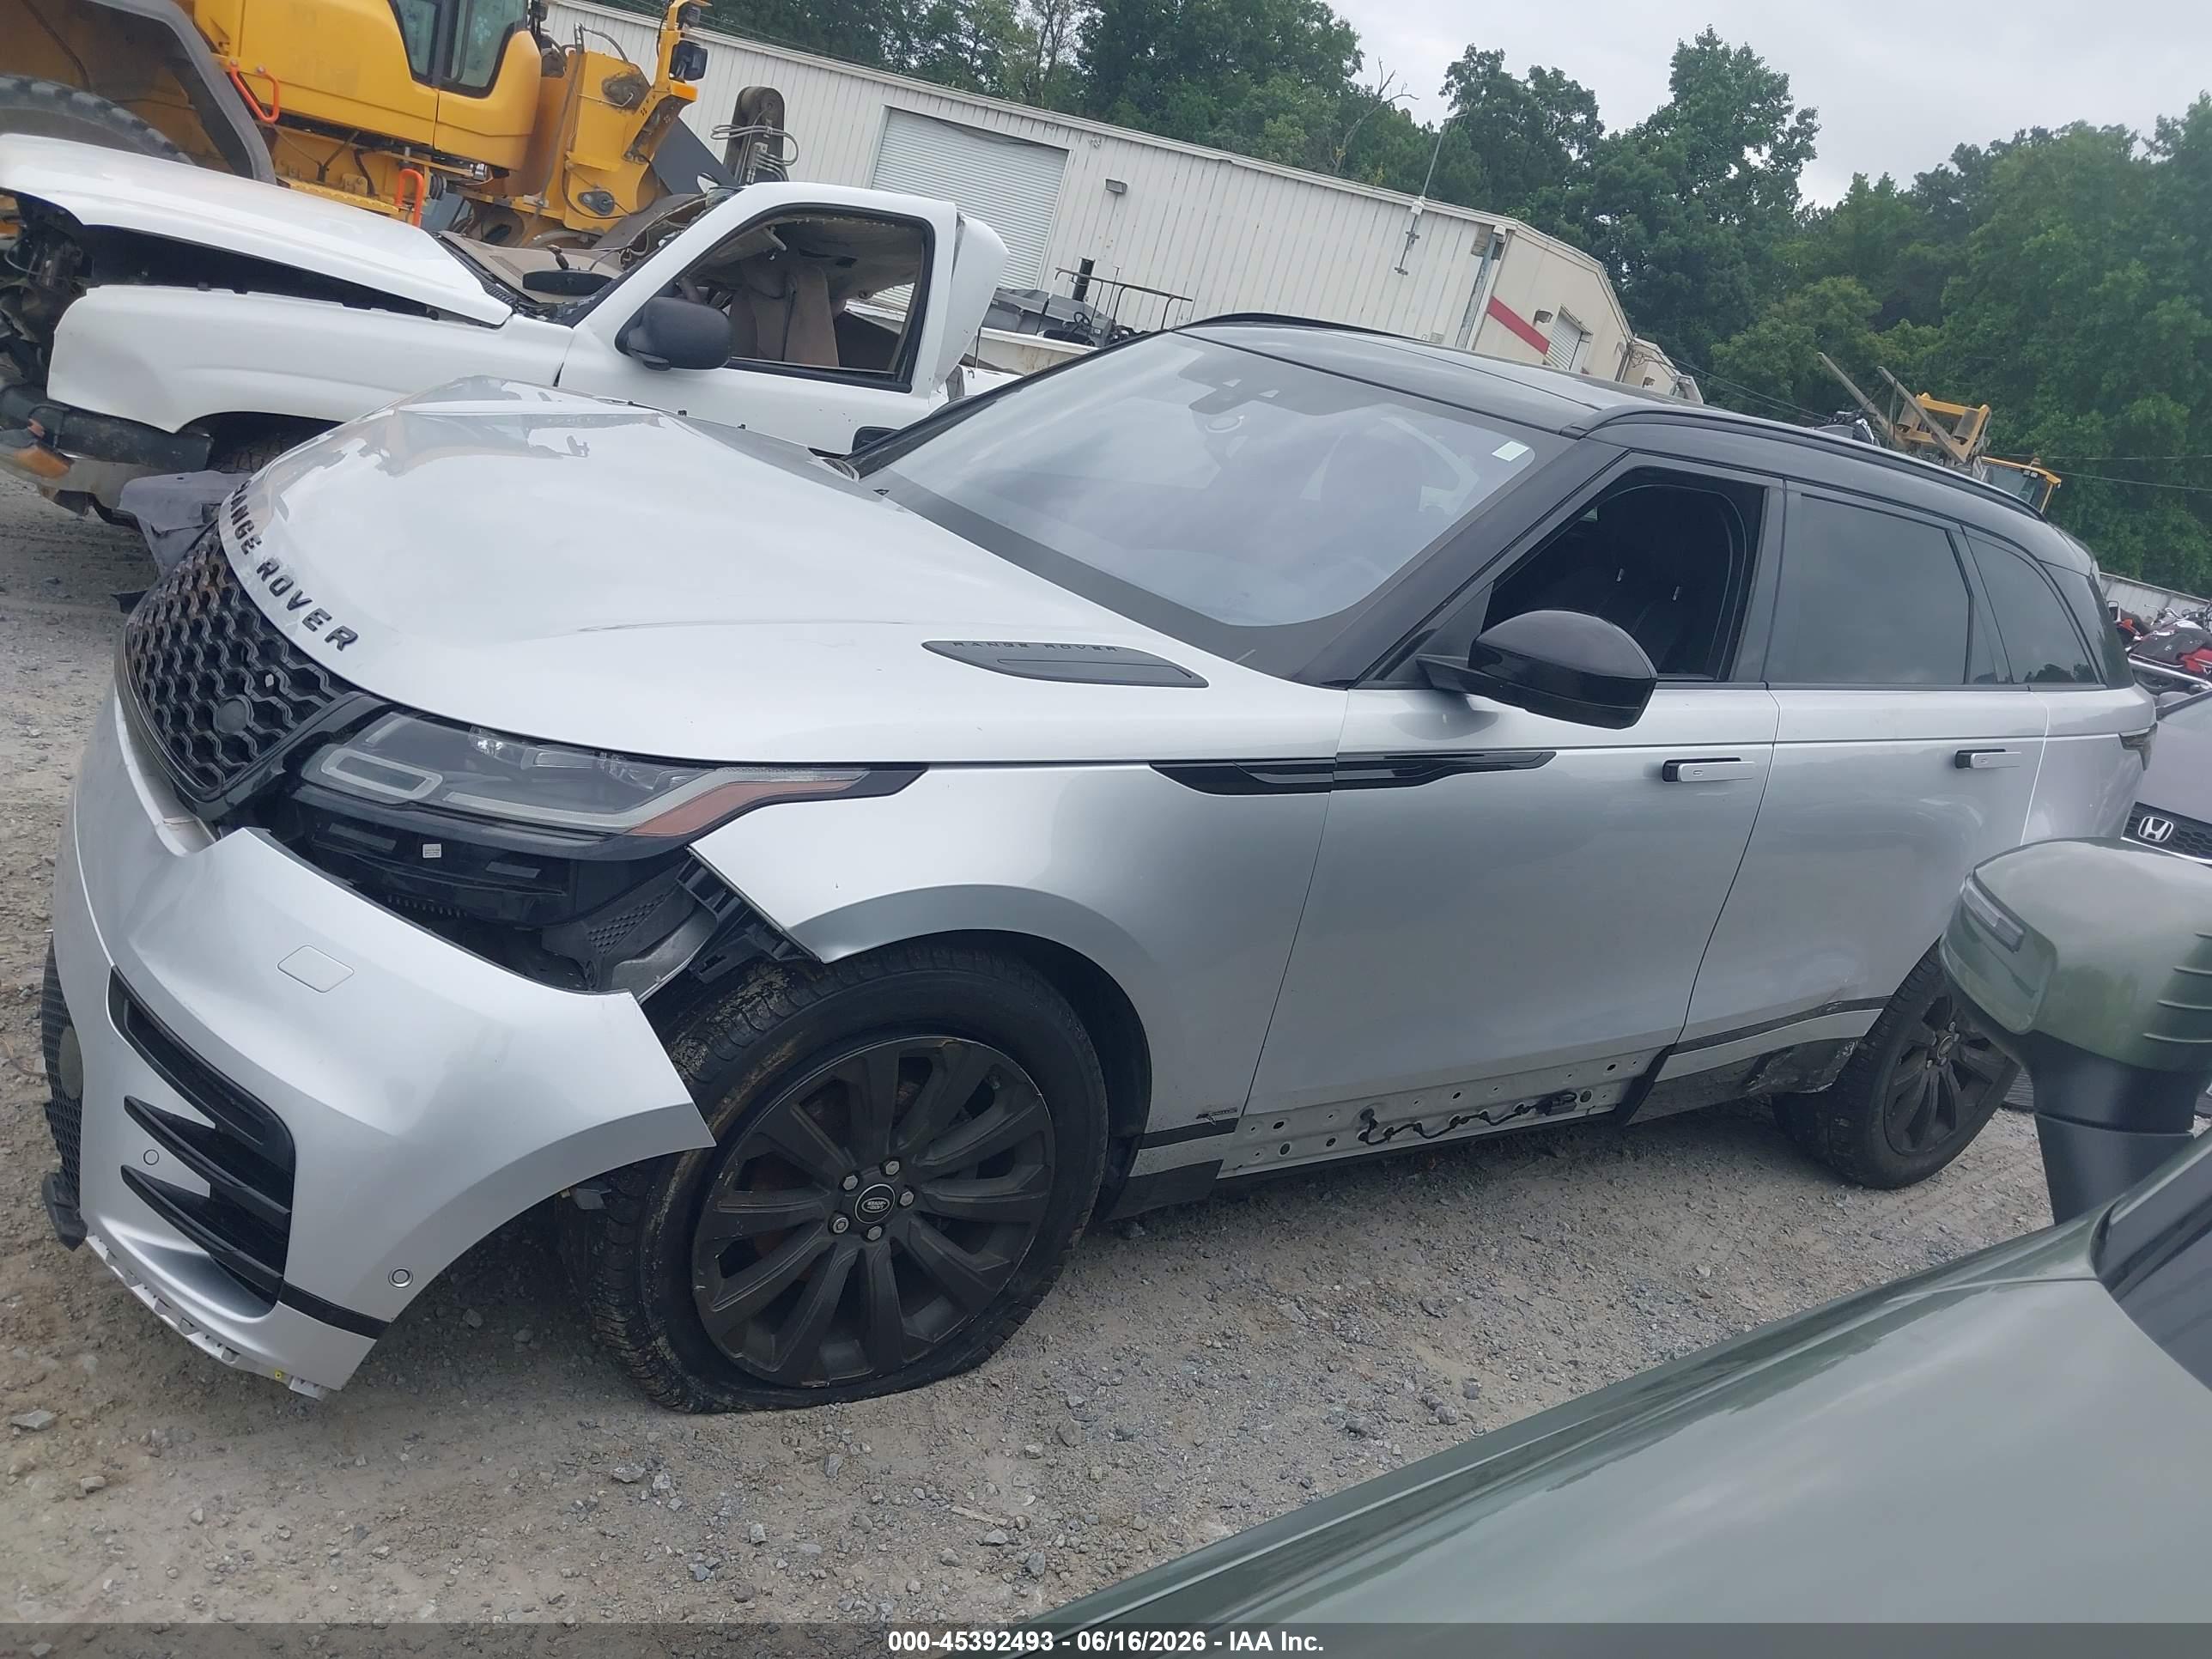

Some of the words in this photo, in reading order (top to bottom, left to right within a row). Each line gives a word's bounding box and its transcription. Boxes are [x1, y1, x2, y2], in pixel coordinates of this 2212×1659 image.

[230, 480, 262, 556] RANGE
[256, 558, 360, 652] ROVER
[1043, 643, 1118, 652] ROVER
